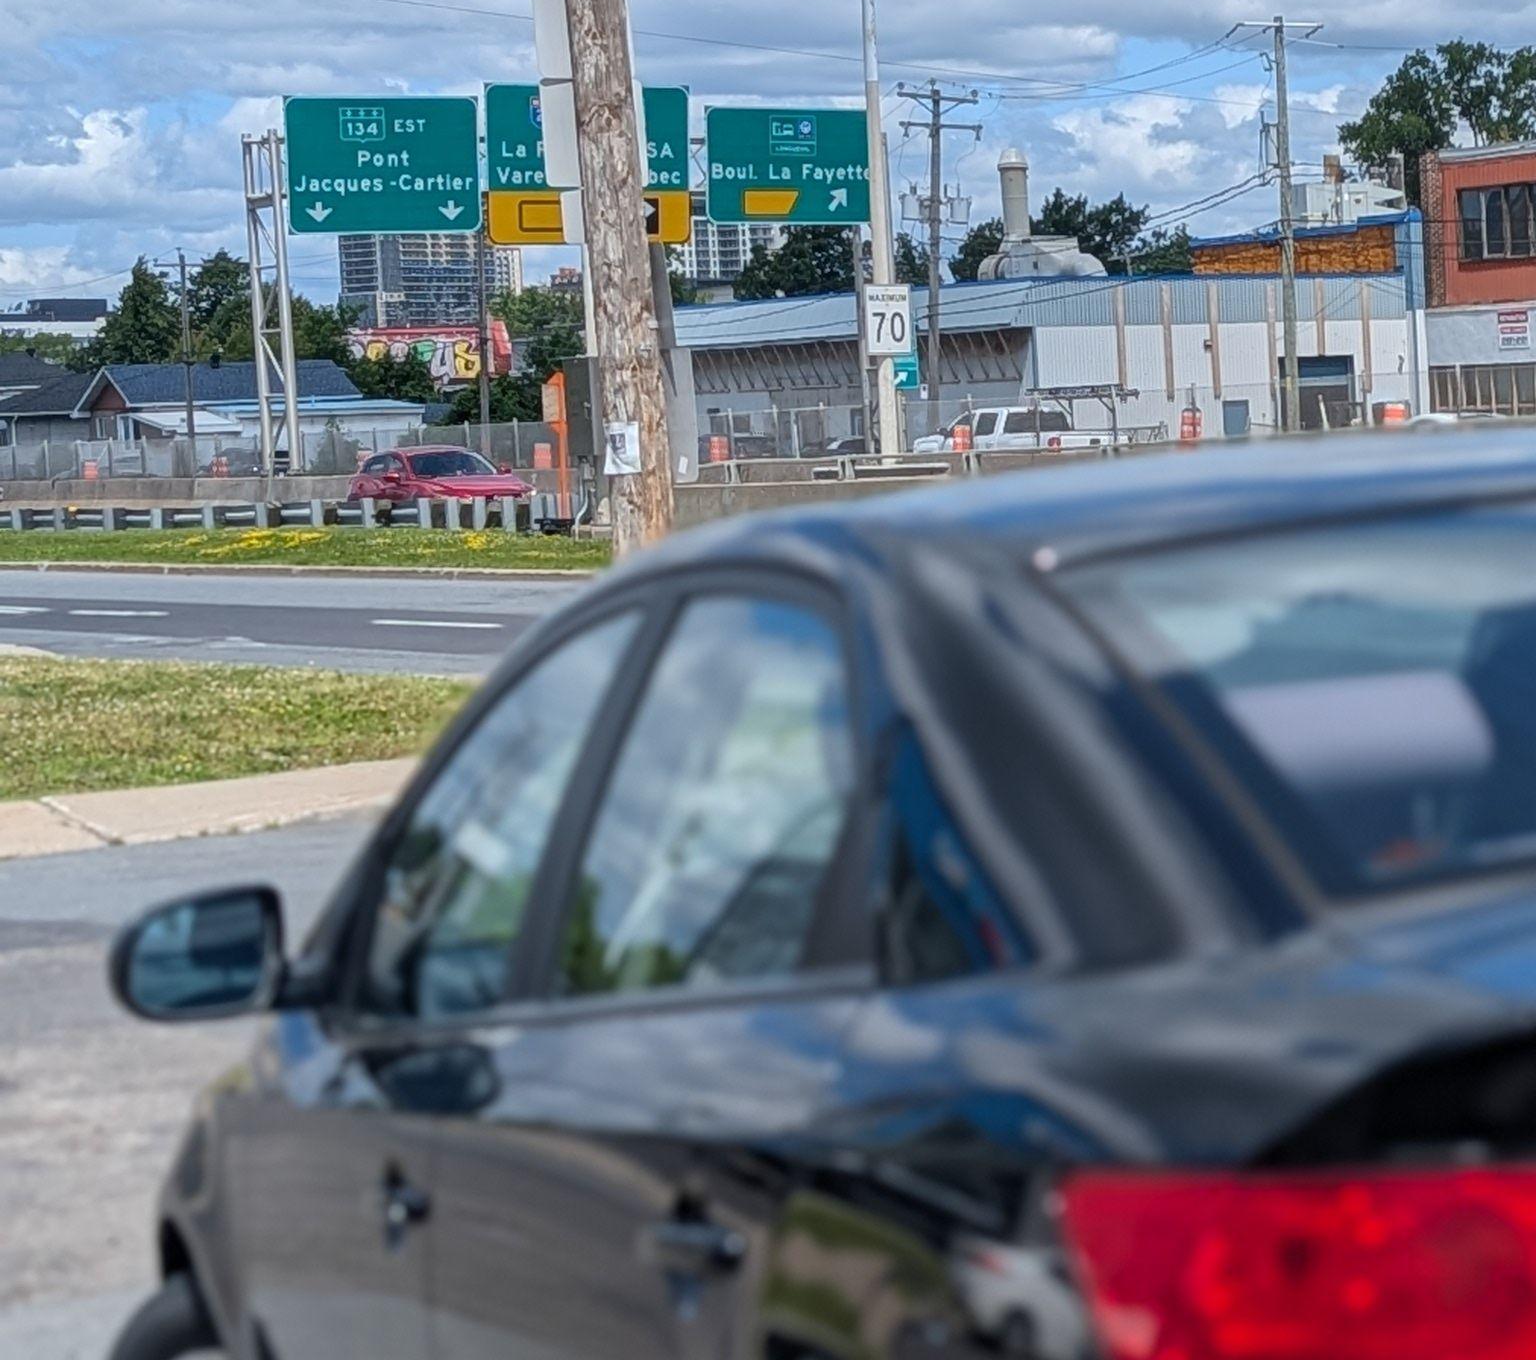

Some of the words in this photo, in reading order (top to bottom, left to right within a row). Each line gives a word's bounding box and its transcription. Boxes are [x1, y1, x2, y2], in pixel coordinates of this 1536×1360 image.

[346, 122, 379, 136] 134
[394, 119, 426, 133] EST
[501, 141, 527, 158] La
[647, 142, 674, 158] SA
[357, 150, 410, 167] Pont
[496, 167, 545, 184] Vare
[648, 168, 681, 185] bec
[711, 163, 758, 180] Boul.
[768, 163, 791, 180] La
[868, 293, 907, 302] MAXIMUM
[872, 312, 905, 343] 70
